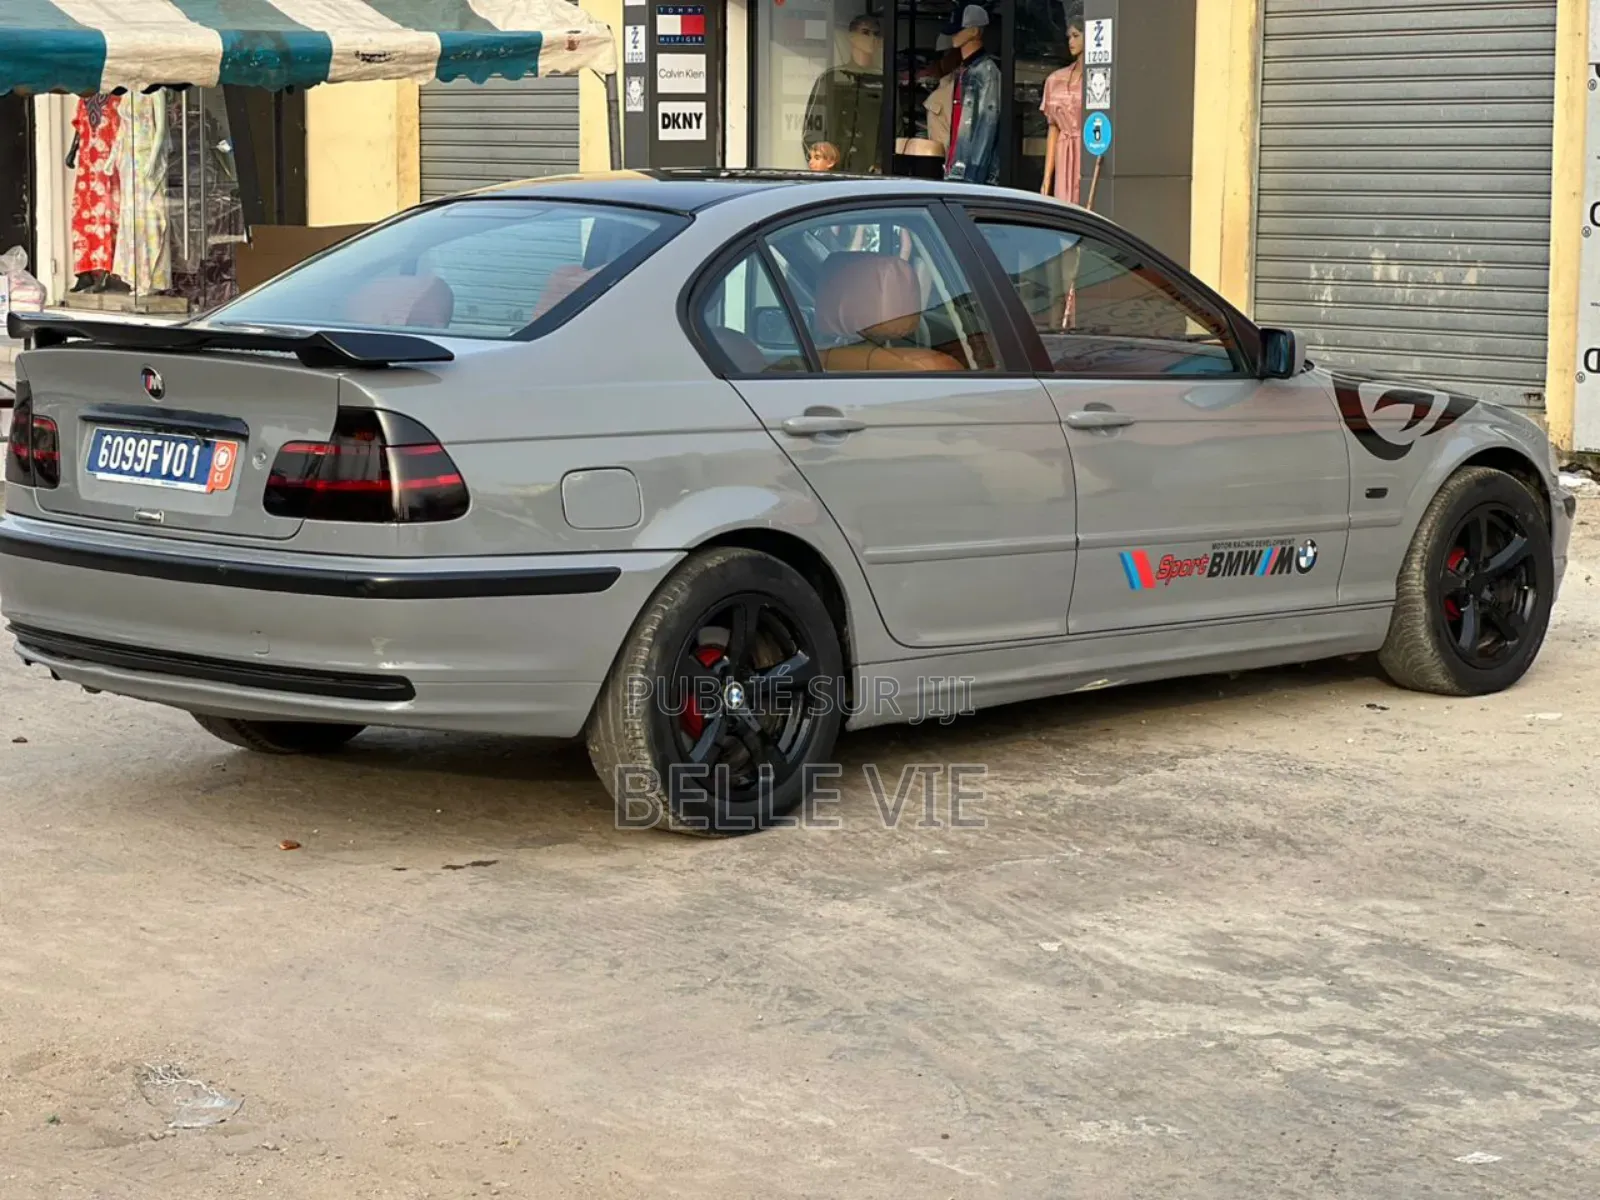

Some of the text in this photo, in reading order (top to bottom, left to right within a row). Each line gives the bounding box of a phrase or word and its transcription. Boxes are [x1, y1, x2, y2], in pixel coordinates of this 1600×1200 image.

[1088, 50, 1110, 63] IZOD
[658, 68, 705, 80] Calvin Klein
[661, 112, 703, 130] DKNY
[98, 434, 200, 479] 6099FV01
[1212, 538, 1296, 550] MOTOR RACING DEVELOPMENT
[1156, 553, 1210, 587] Sport
[1207, 549, 1263, 578] BMW
